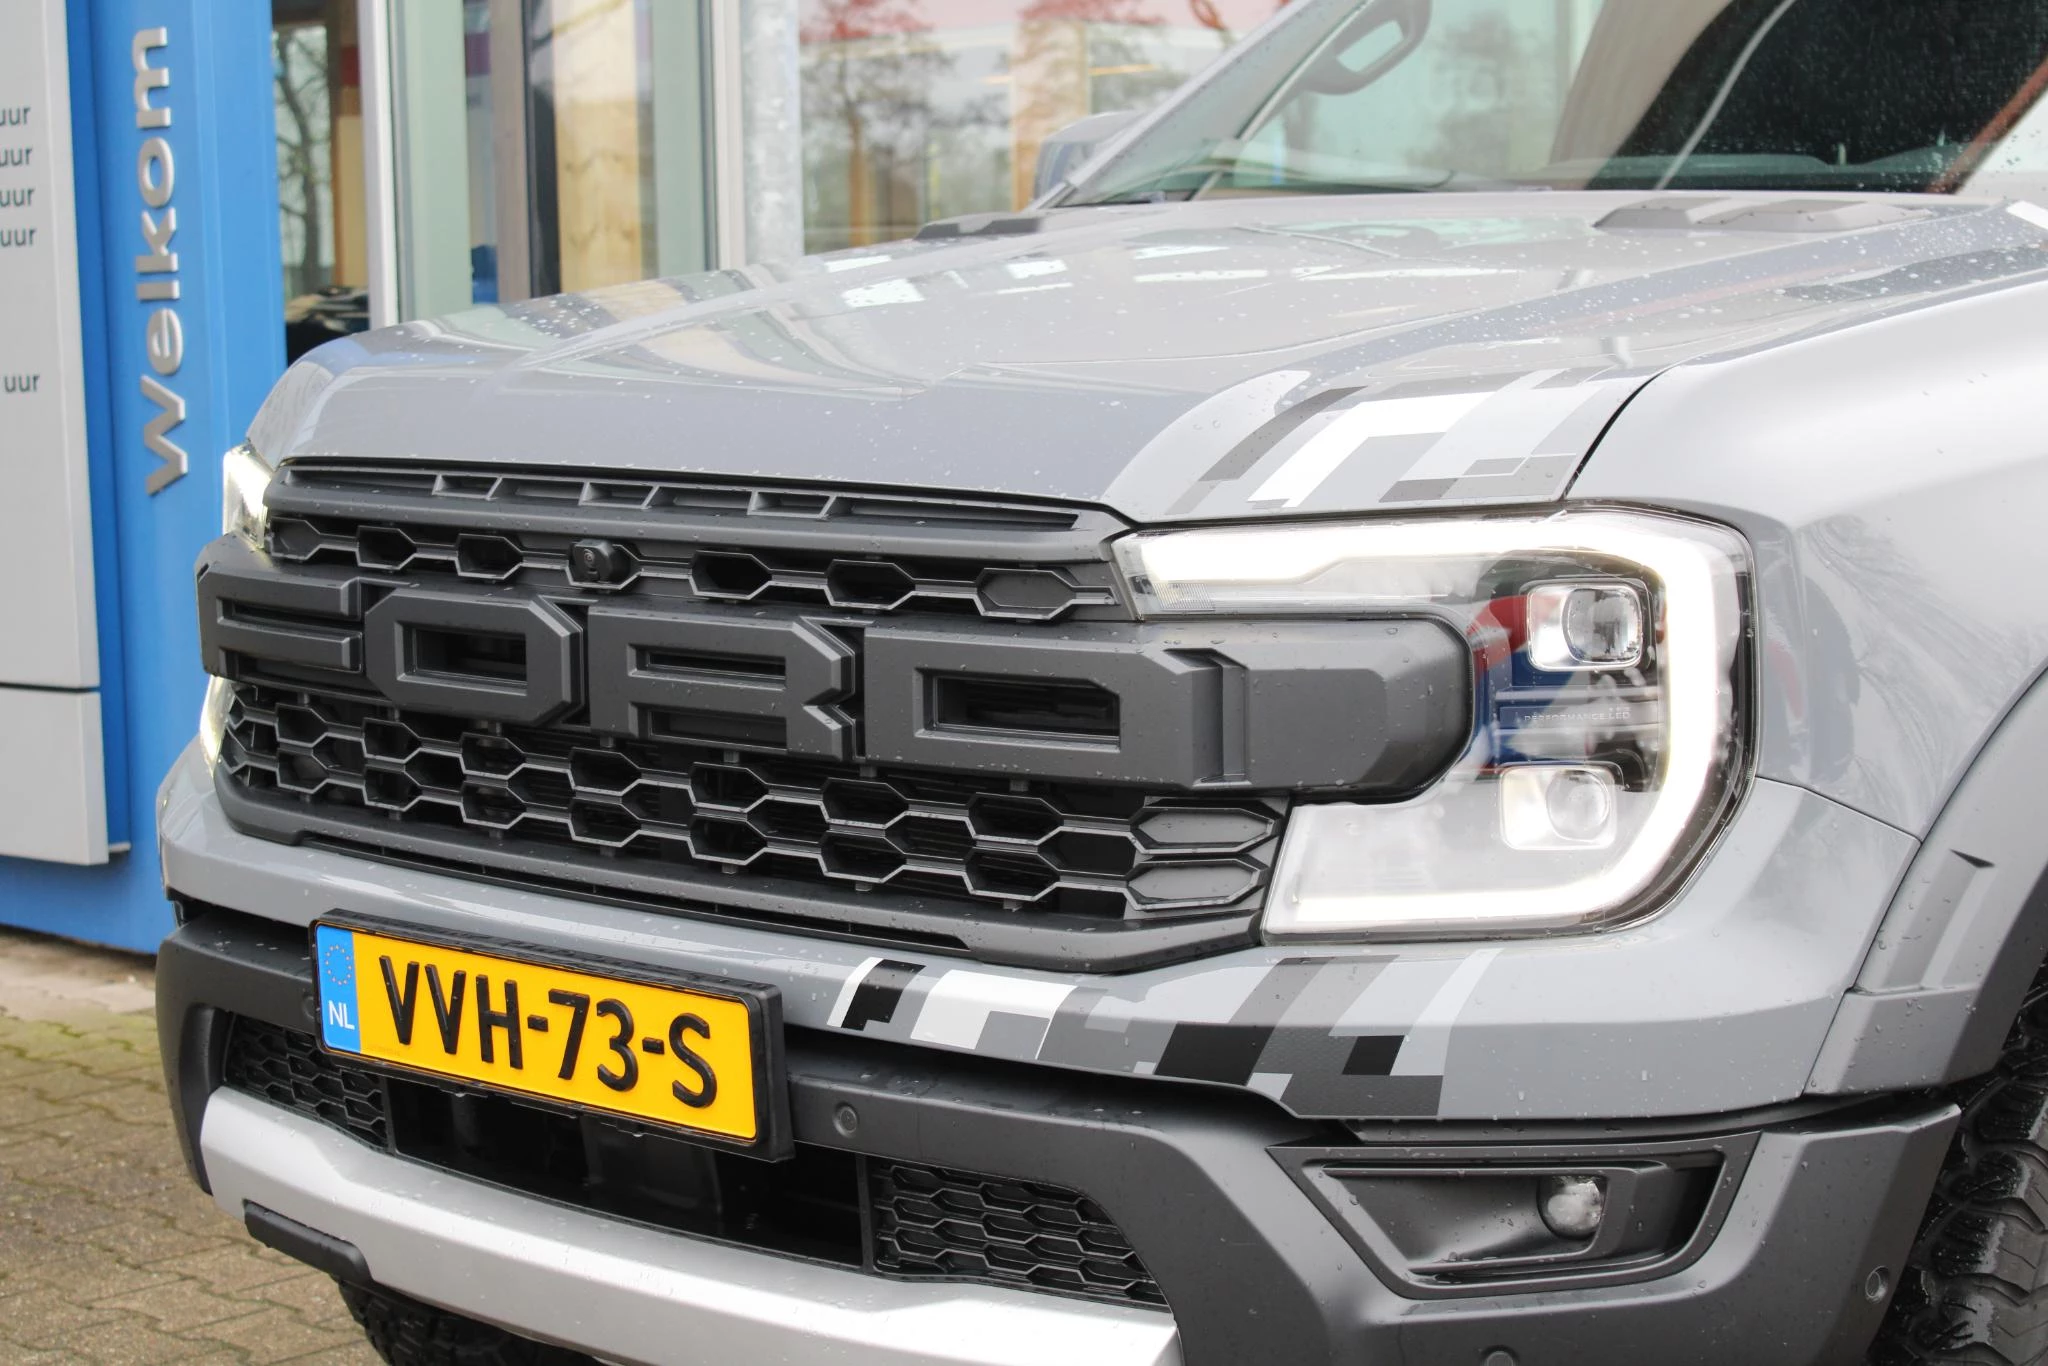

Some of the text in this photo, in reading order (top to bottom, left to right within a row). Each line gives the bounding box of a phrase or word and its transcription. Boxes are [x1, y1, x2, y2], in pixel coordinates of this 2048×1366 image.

[0, 147, 33, 167] uur
[0, 187, 35, 207] uur
[0, 227, 37, 247] uur
[132, 26, 189, 496] Welkom
[4, 375, 40, 393] uur
[197, 569, 1224, 791] FORD
[328, 999, 355, 1030] NL
[378, 955, 718, 1109] VVH-73-S
